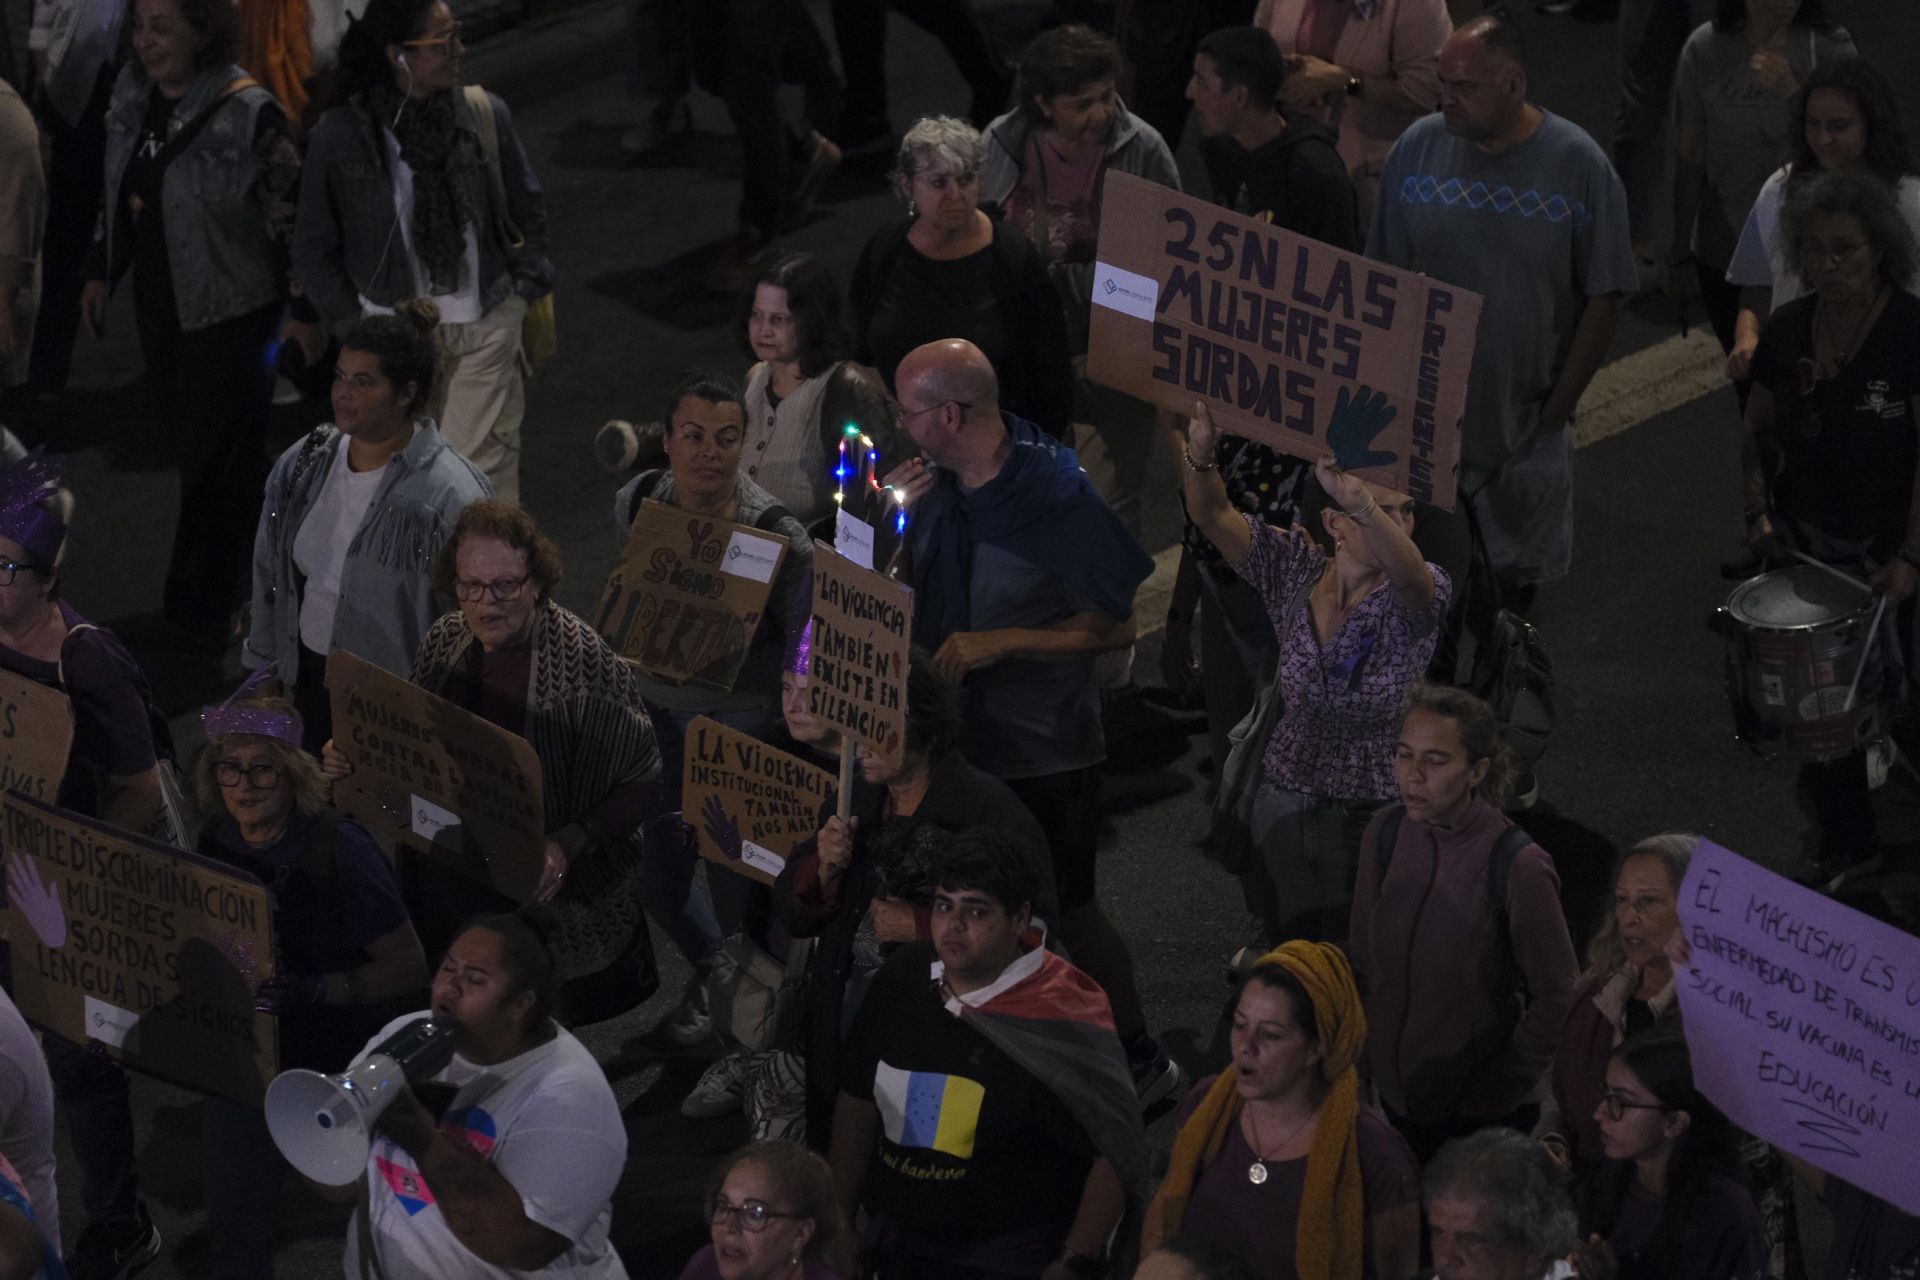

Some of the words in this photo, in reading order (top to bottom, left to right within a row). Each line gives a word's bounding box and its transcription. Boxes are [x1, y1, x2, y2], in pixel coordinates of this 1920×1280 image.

[1164, 207, 1278, 290] 25N
[1292, 245, 1397, 330] LAS
[1156, 265, 1362, 380] MUJERES
[1153, 321, 1316, 435] SORDAS
[813, 614, 889, 677] TAMBIÉN
[880, 683, 899, 710] EN
[353, 725, 441, 776] CONTRA
[698, 727, 725, 765] LA
[752, 819, 781, 840] NOS
[71, 919, 181, 982] SORDAS
[1692, 924, 1805, 994] ENFERMEDAD
[1813, 980, 1838, 1012] DE
[1695, 868, 1721, 913] EL
[1745, 895, 1858, 972] MACHISMO
[1860, 953, 1898, 992] ES
[37, 943, 127, 1005] LENGUA
[138, 980, 163, 1014] DE
[1688, 968, 1758, 1021] SOCIAL
[1766, 1010, 1792, 1033] SU
[1799, 1020, 1865, 1073] VACUNA
[1870, 1060, 1893, 1086] ES
[1758, 1050, 1888, 1131] EDUCACIÓN
